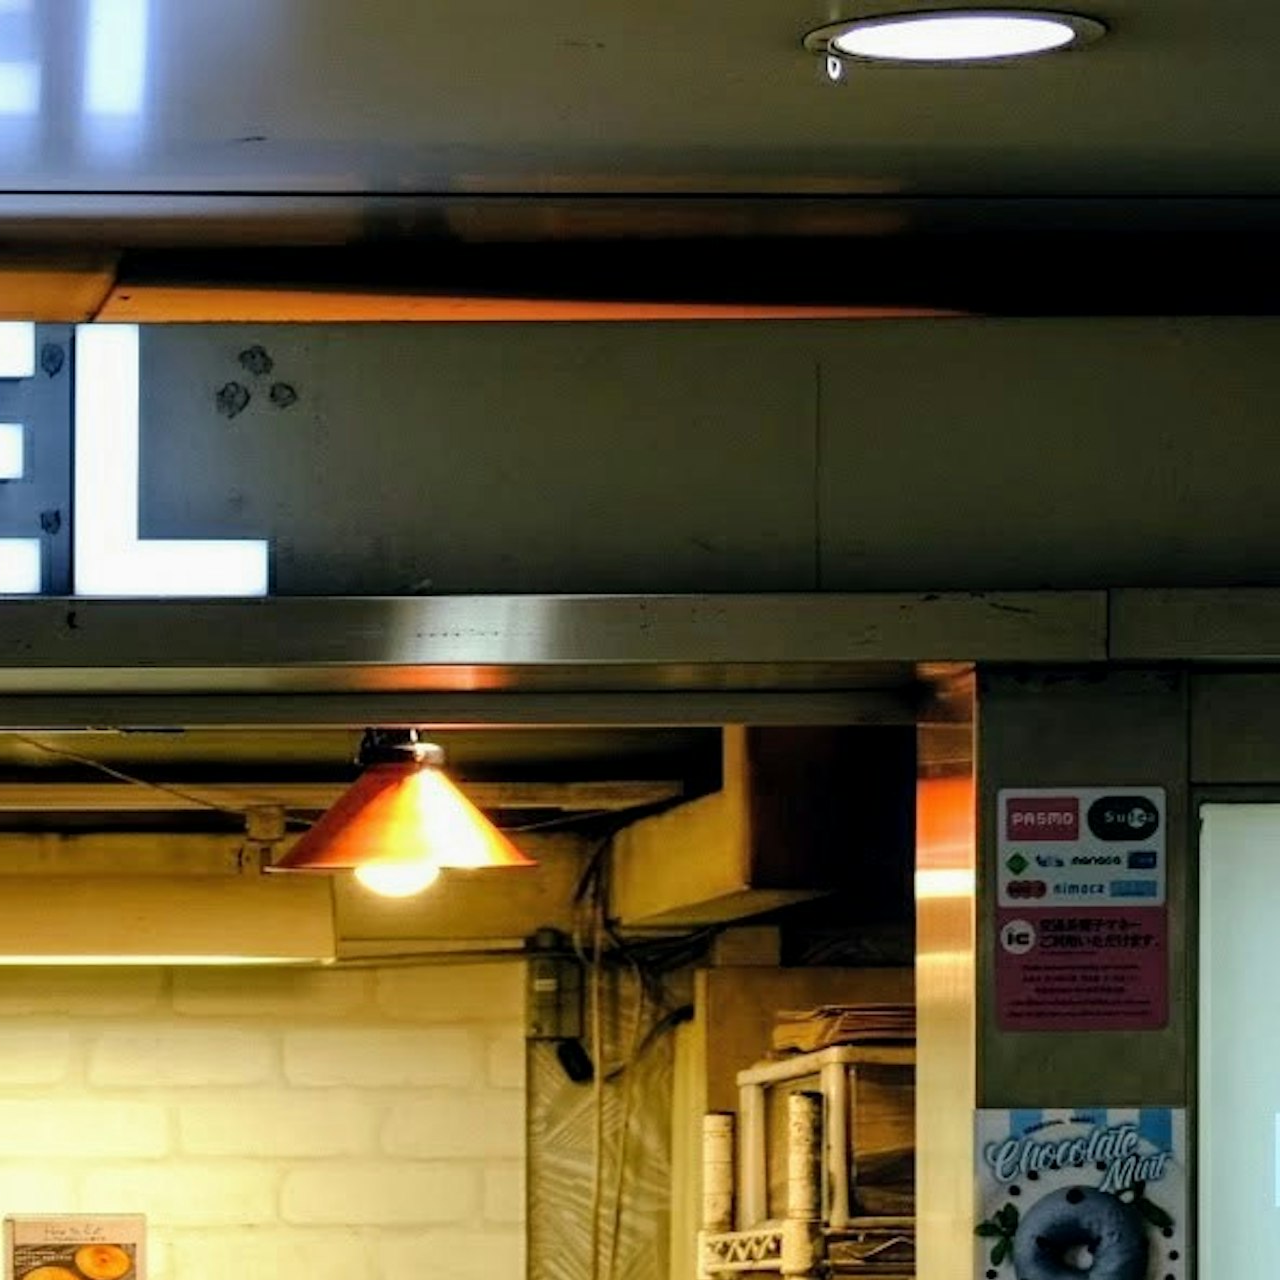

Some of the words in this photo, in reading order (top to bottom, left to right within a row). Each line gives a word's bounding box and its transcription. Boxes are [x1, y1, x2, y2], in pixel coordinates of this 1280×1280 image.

[1012, 810, 1073, 826] PASMO
[986, 1124, 1138, 1182] Chocolate
[1100, 1154, 1173, 1192] Mint
